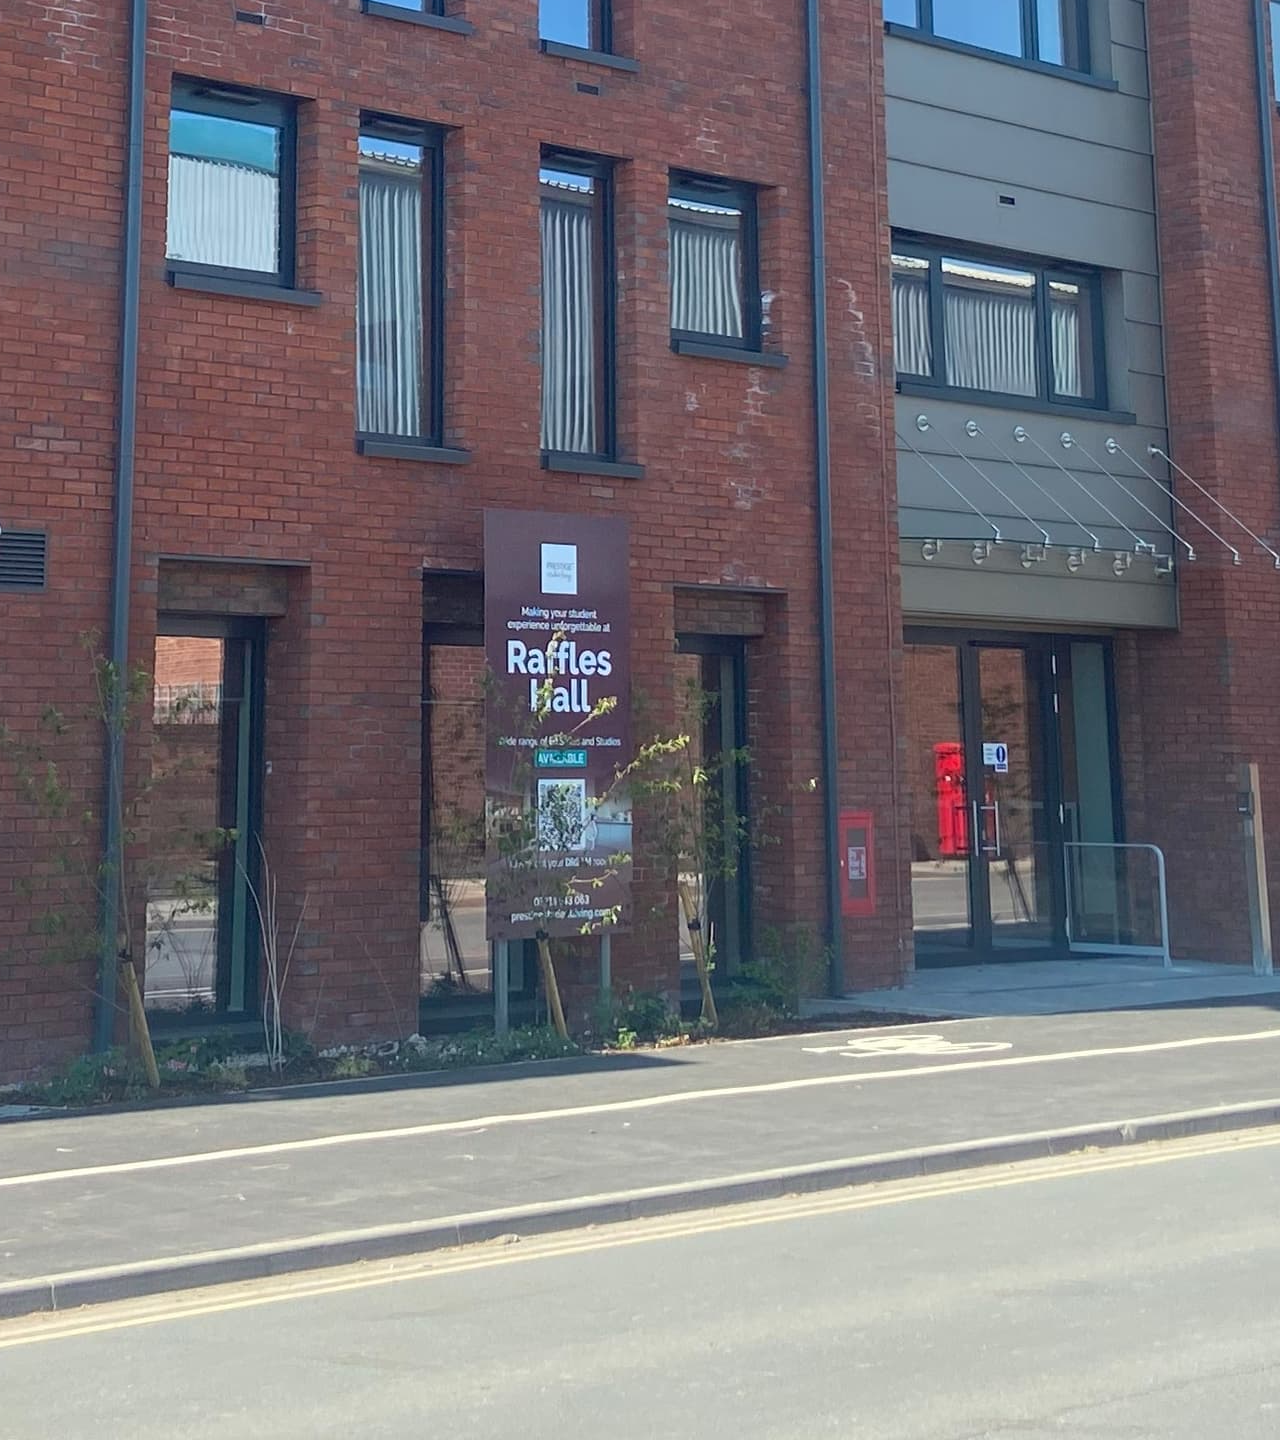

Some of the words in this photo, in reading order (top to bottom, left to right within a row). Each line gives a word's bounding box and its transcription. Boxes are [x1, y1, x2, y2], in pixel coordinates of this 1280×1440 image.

[521, 607, 549, 619] Making
[550, 609, 567, 619] your
[568, 609, 597, 619] student
[507, 621, 549, 631] experience
[551, 621, 601, 633] unforgettable
[602, 623, 610, 632] at
[507, 640, 611, 676] Raffles
[582, 737, 594, 746] and
[596, 736, 621, 746] Studios
